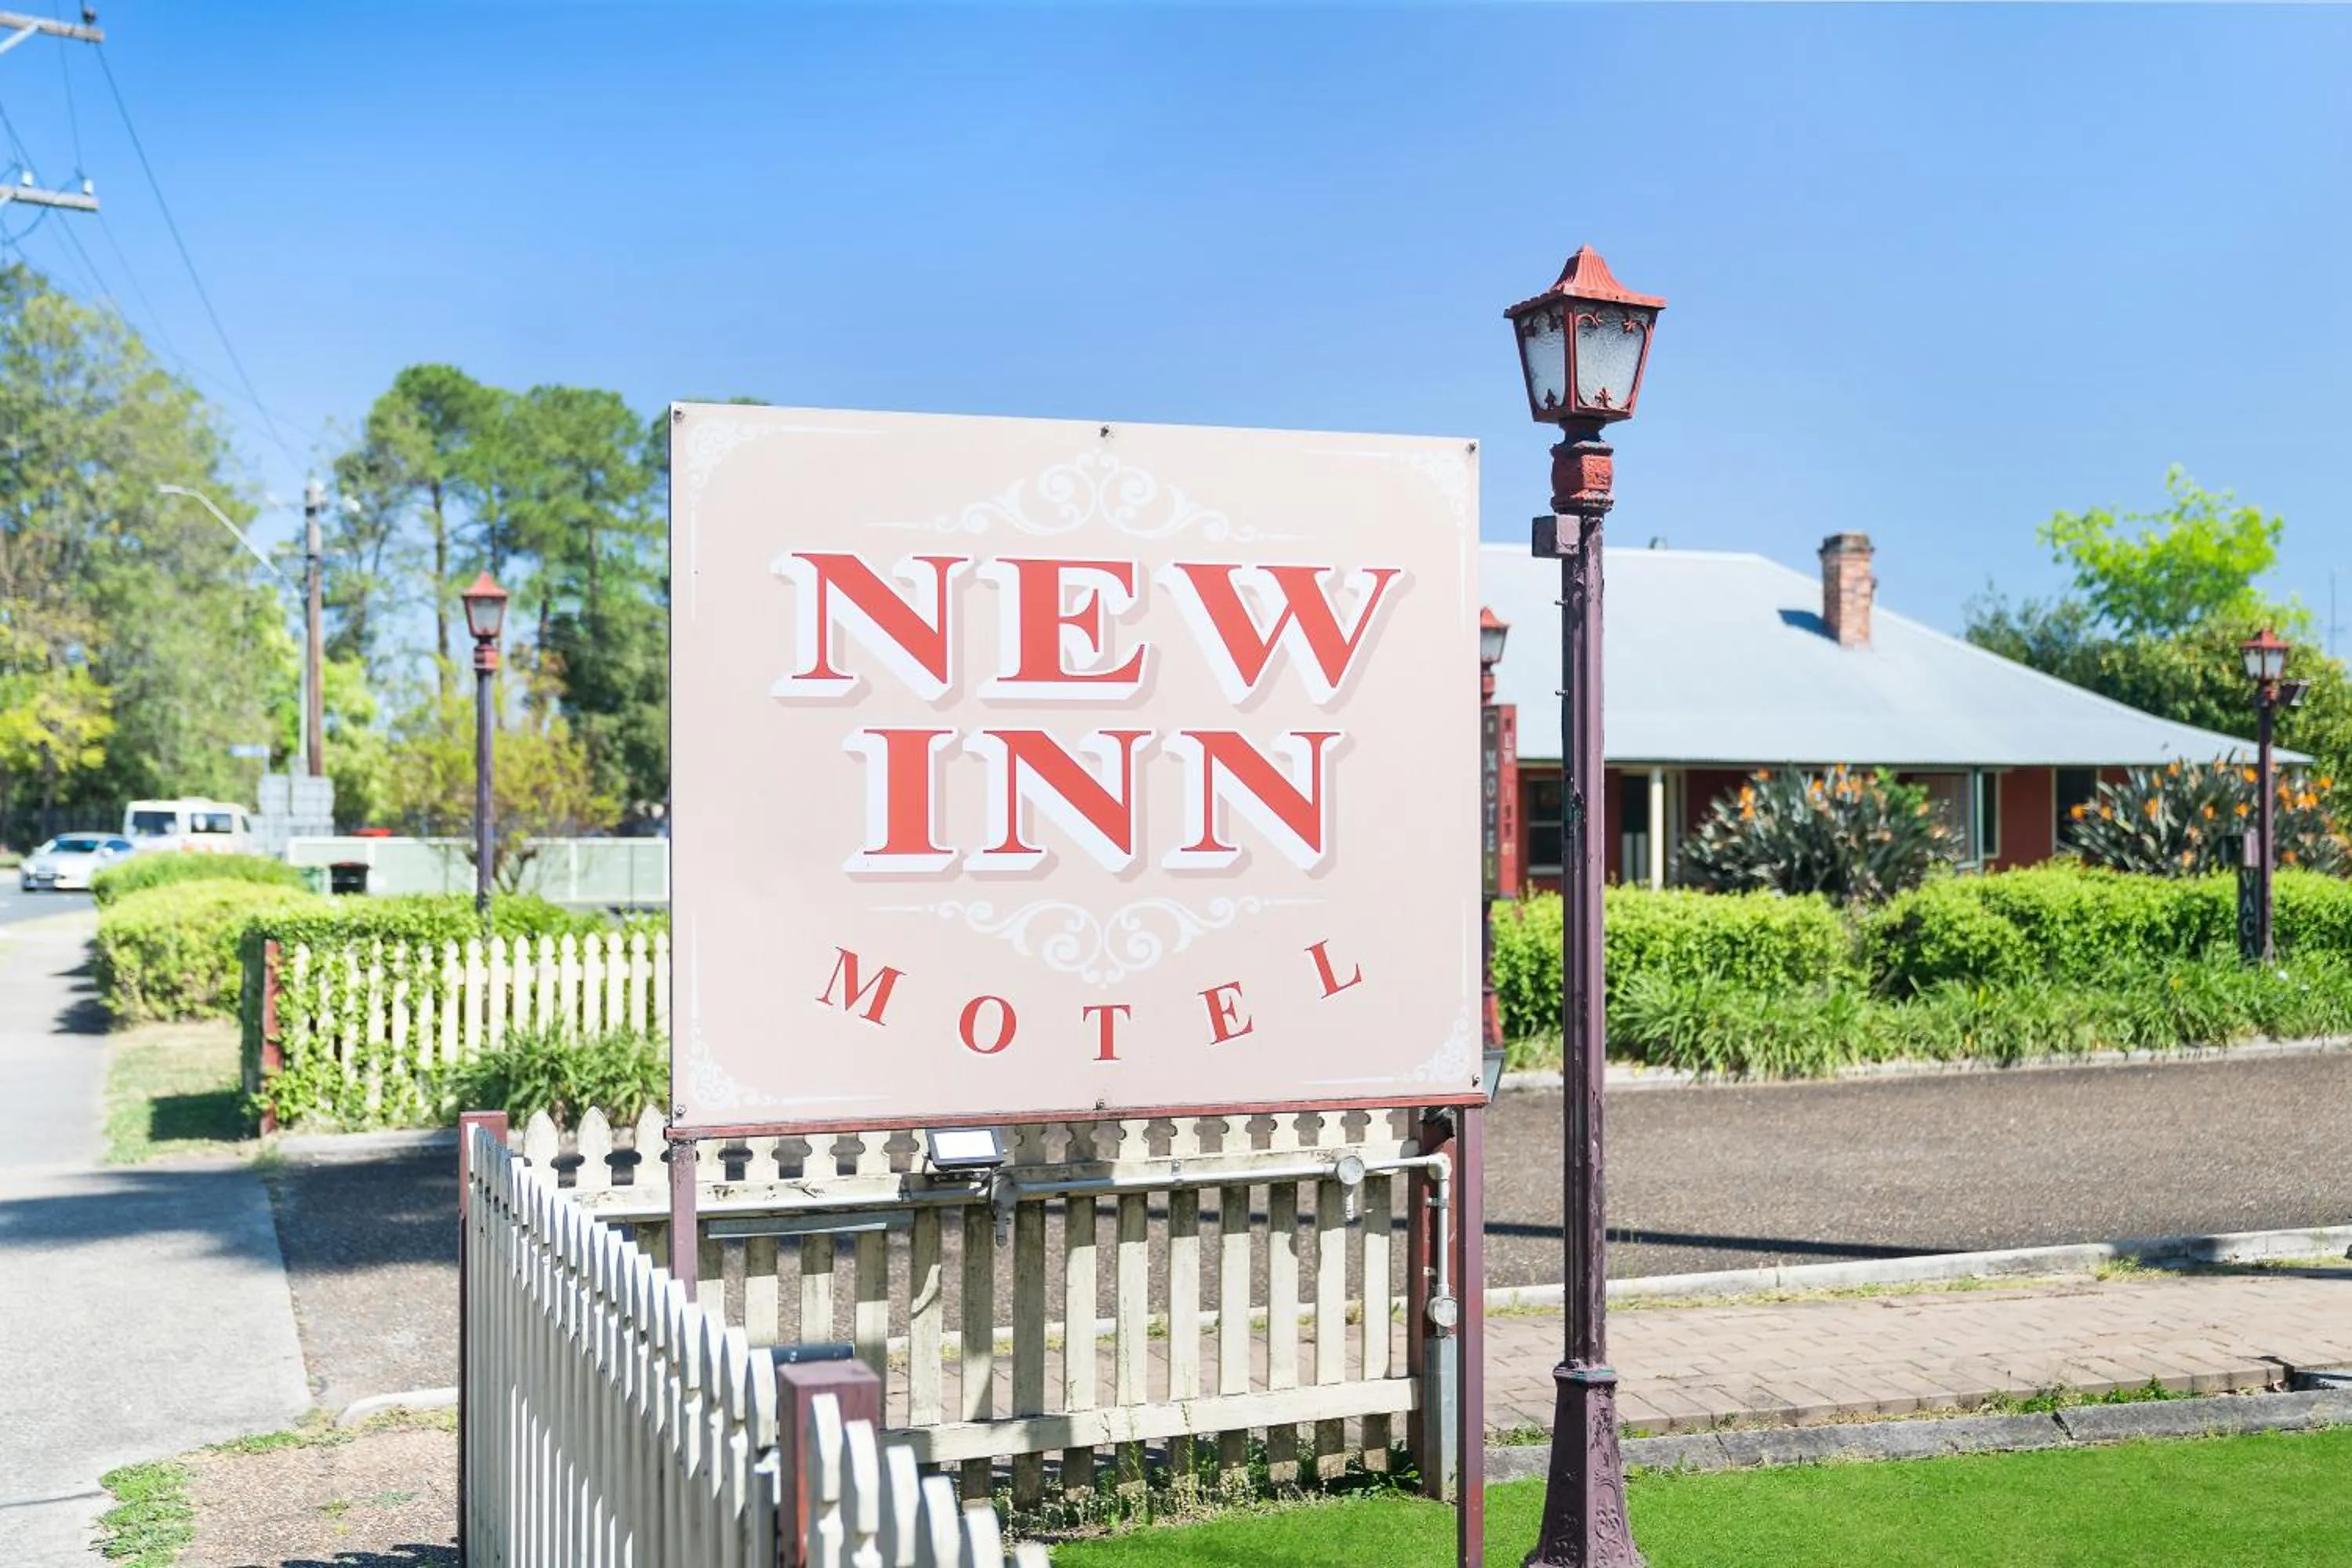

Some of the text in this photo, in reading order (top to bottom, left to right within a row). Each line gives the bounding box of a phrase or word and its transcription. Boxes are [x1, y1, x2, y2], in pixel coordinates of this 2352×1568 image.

[780, 550, 1403, 696] NEW
[855, 728, 1342, 862] INN
[815, 938, 1363, 1061] MOTEL
